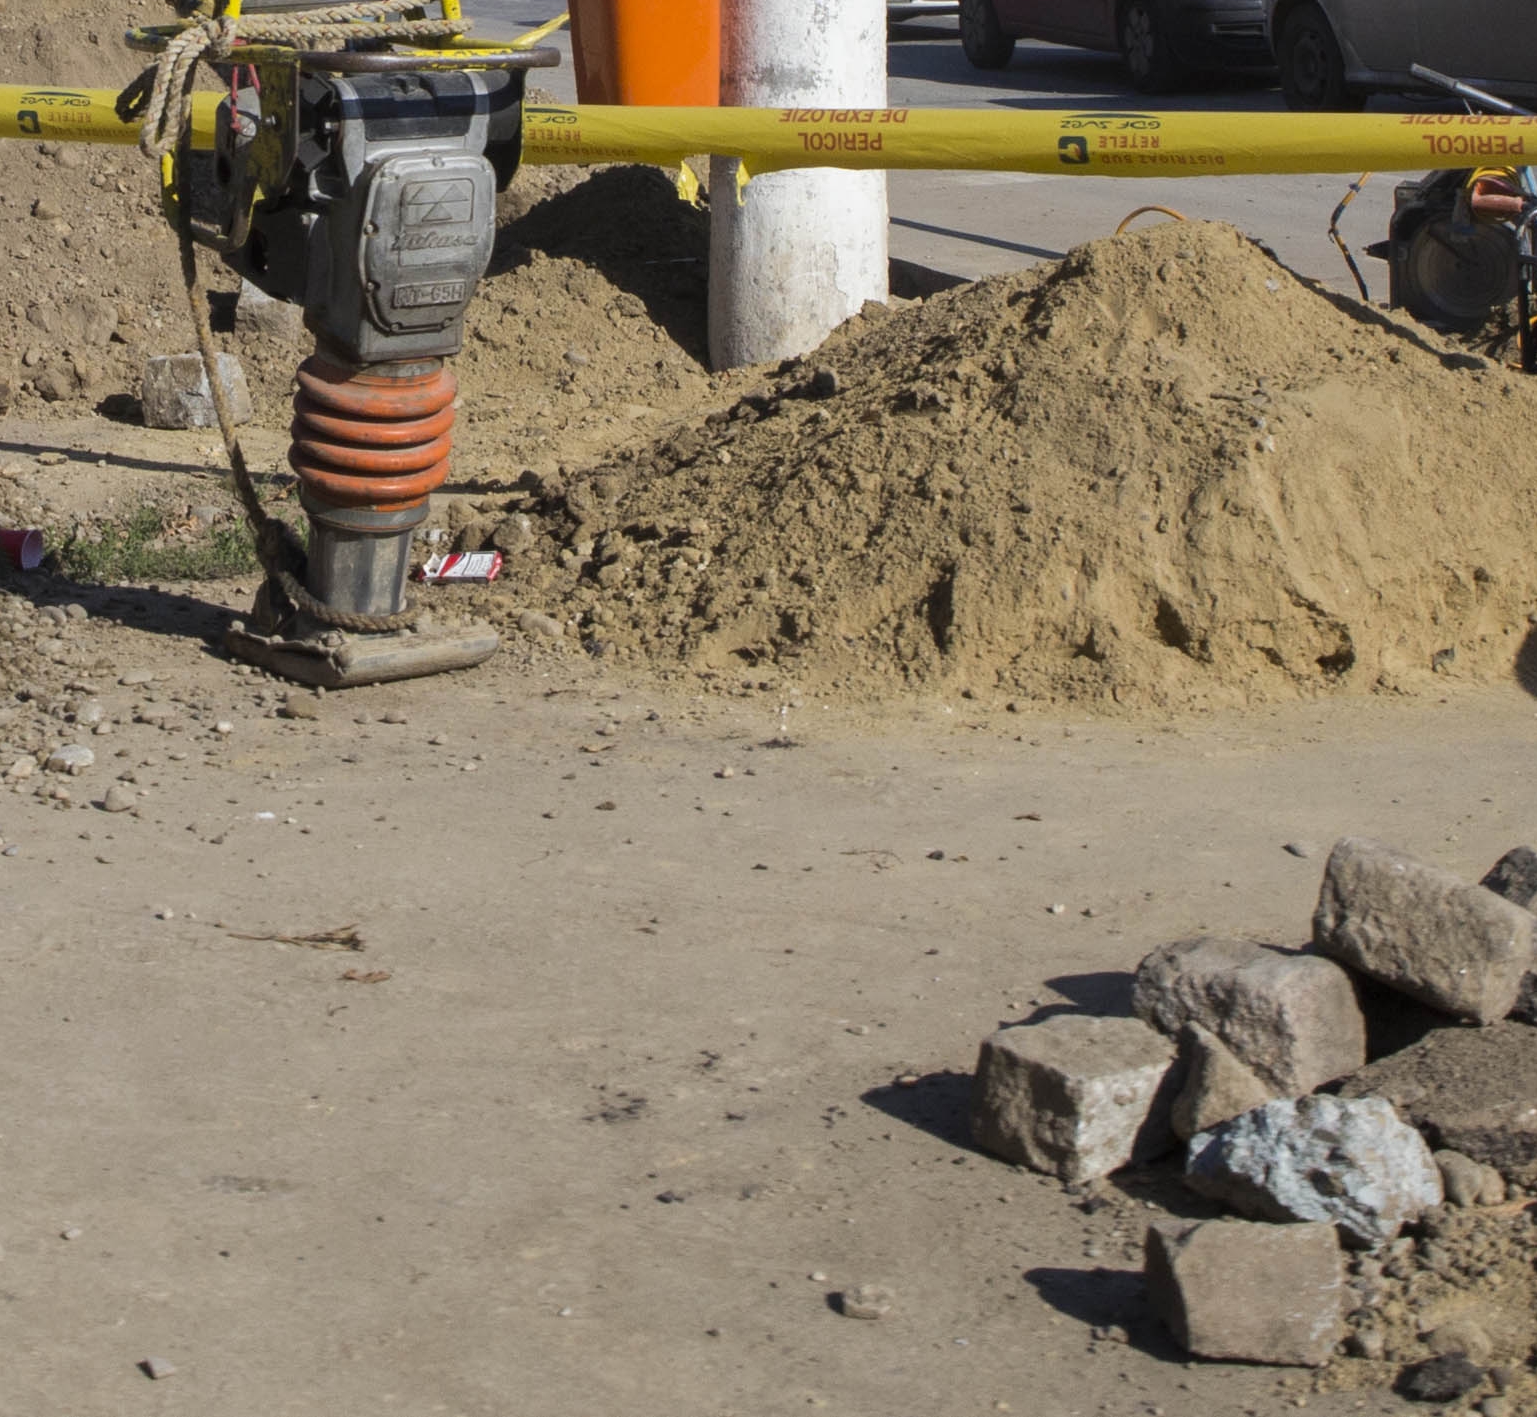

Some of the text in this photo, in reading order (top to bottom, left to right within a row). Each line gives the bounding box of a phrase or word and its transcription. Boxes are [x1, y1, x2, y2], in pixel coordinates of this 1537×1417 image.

[778, 109, 909, 124] DE EXPLOZIE
[1115, 120, 1161, 130] GDF
[797, 132, 883, 152] PERICOL
[1422, 135, 1526, 156] PERICOL
